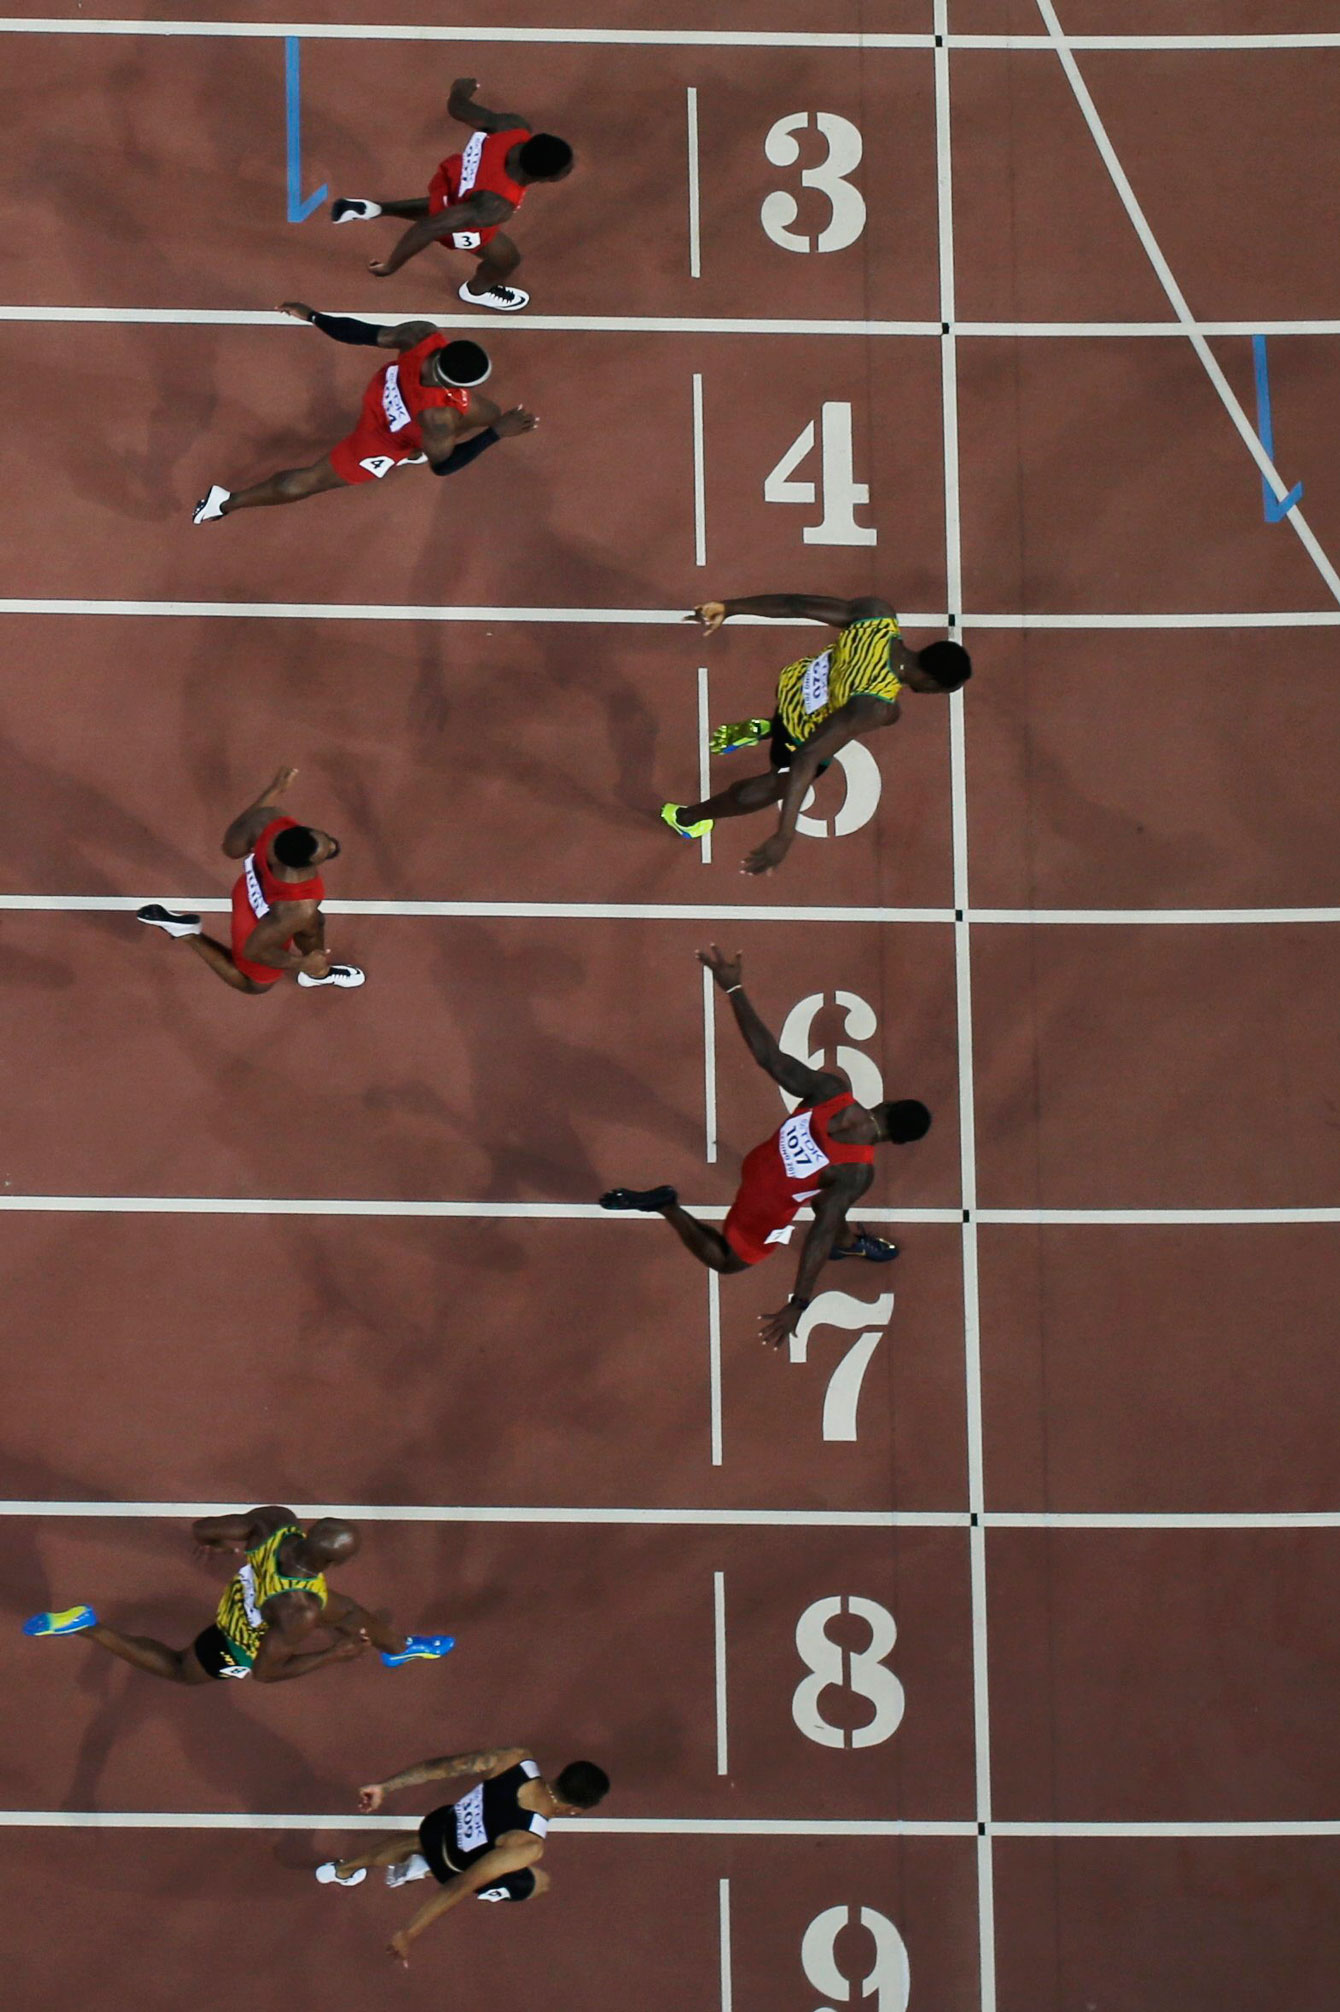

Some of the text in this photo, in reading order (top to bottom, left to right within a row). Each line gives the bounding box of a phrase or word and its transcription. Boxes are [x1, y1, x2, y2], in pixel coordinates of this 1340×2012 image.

[461, 235, 473, 247] 3
[761, 112, 866, 252] 3
[370, 459, 385, 470] 4
[765, 402, 877, 545] 4
[779, 991, 883, 1114] 6
[786, 1124, 813, 1165] 1017
[788, 1291, 894, 1442] 7
[792, 1596, 904, 1748] 8
[802, 1906, 910, 2012] 9
